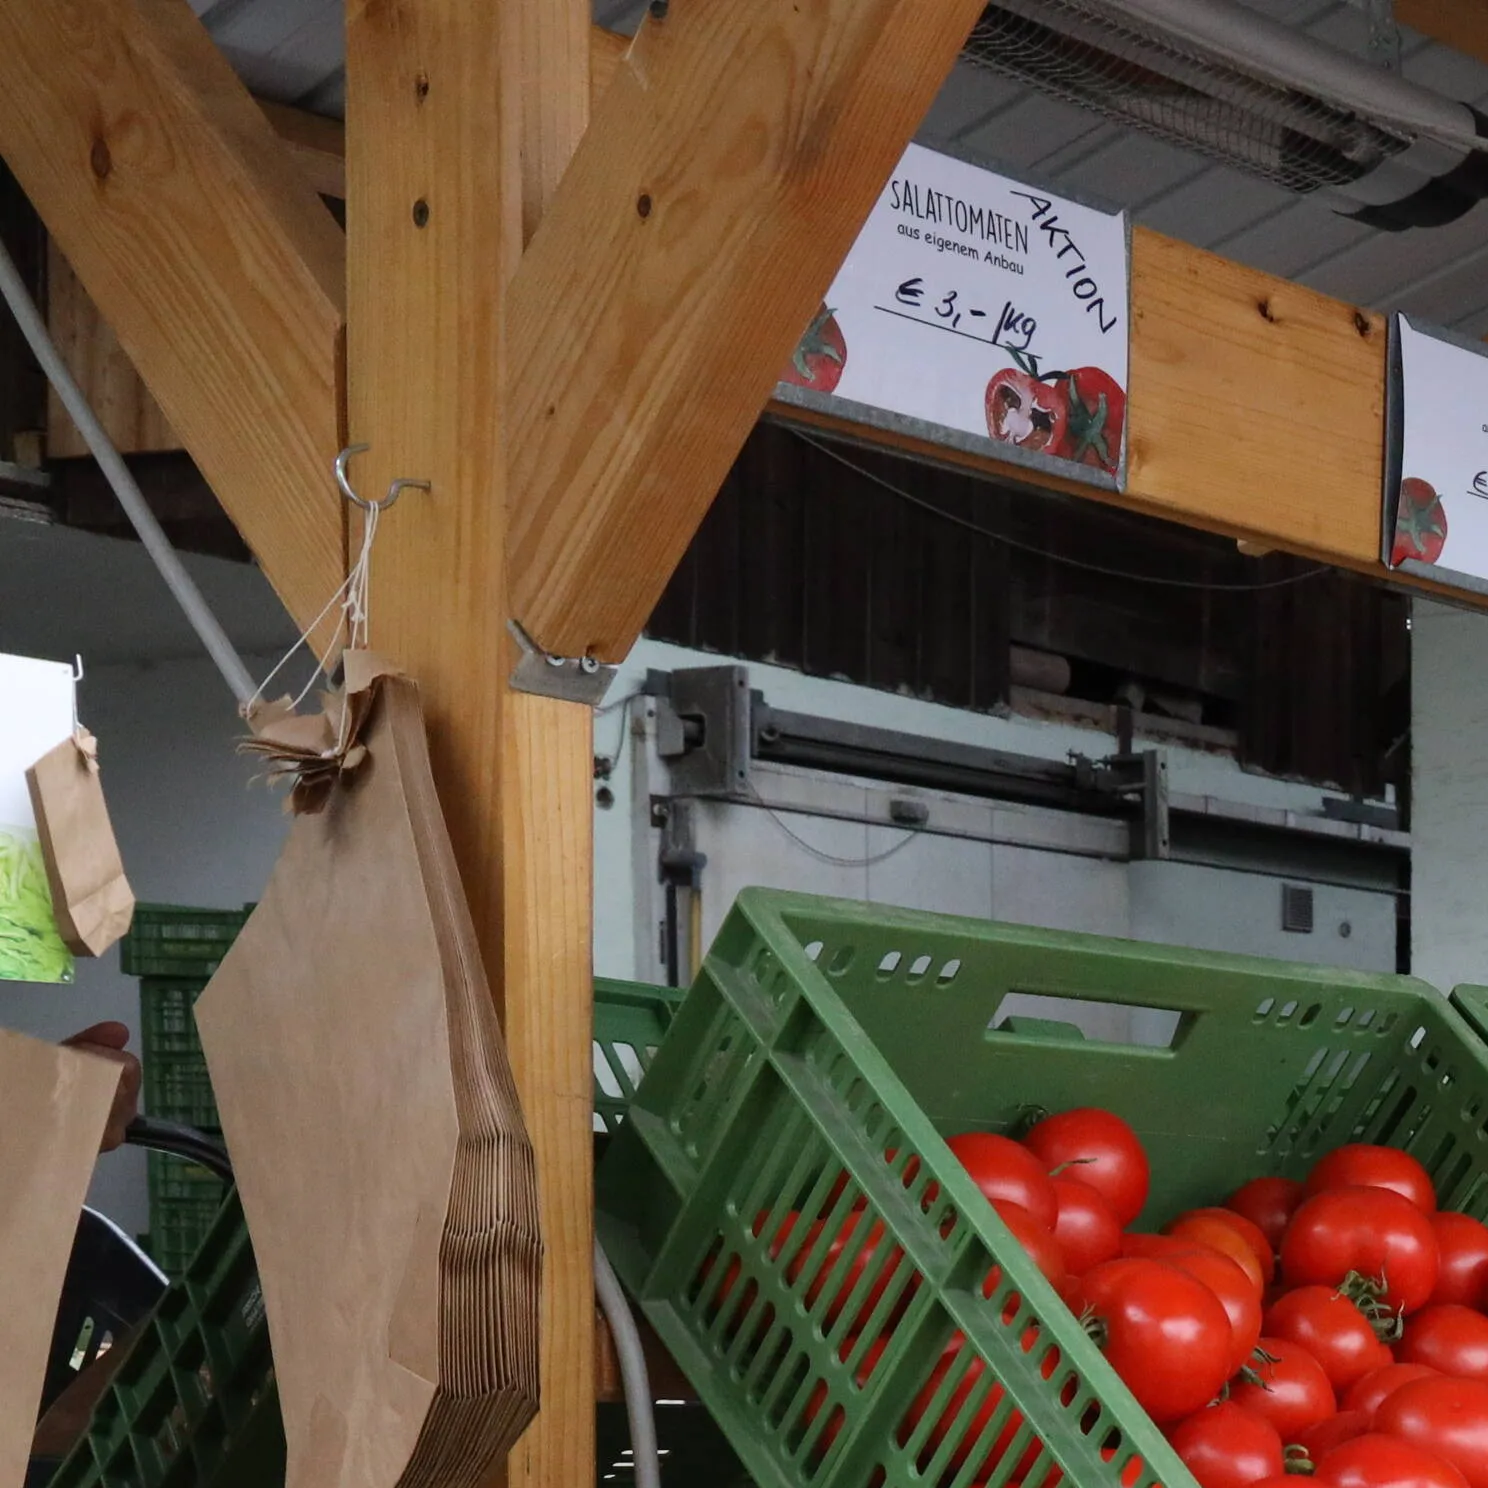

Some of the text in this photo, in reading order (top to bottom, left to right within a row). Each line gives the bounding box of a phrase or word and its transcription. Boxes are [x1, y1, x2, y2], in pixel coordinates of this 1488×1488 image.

[890, 178, 1029, 255] SALATTOMATEN
[896, 223, 1025, 276] aus eigenem Anbau
[1010, 189, 1118, 335] AKTION
